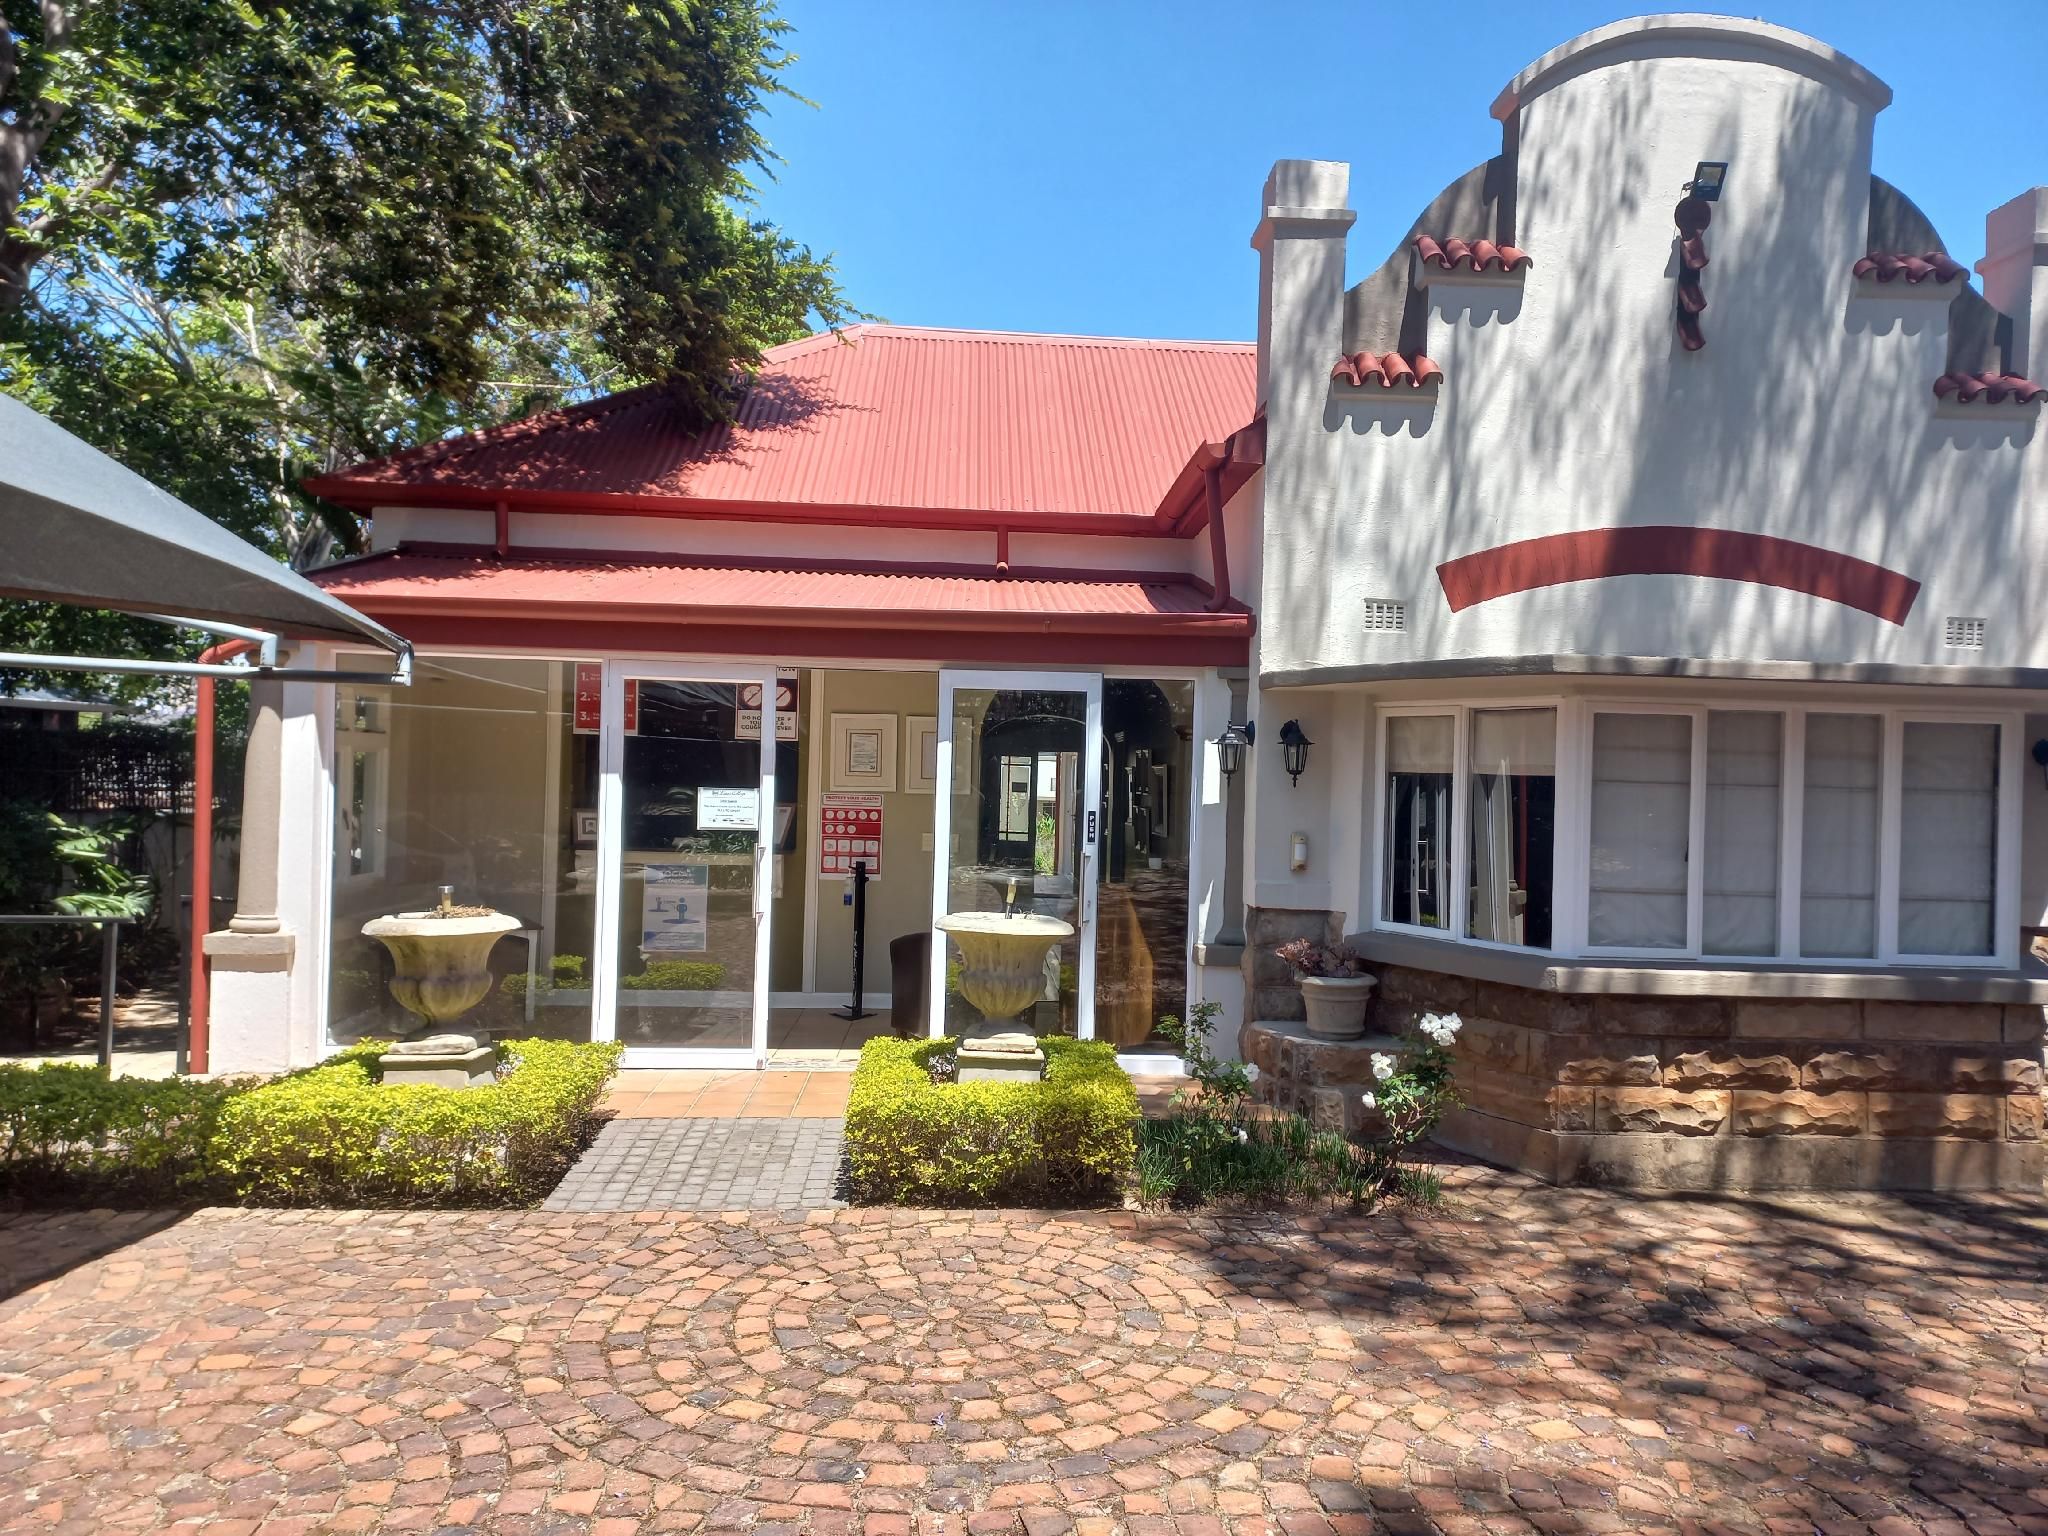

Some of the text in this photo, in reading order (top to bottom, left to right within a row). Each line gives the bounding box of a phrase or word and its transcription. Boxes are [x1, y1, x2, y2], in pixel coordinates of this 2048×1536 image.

[581, 672, 589, 680] 1.
[580, 692, 590, 701] 2.
[580, 712, 590, 720] 3.
